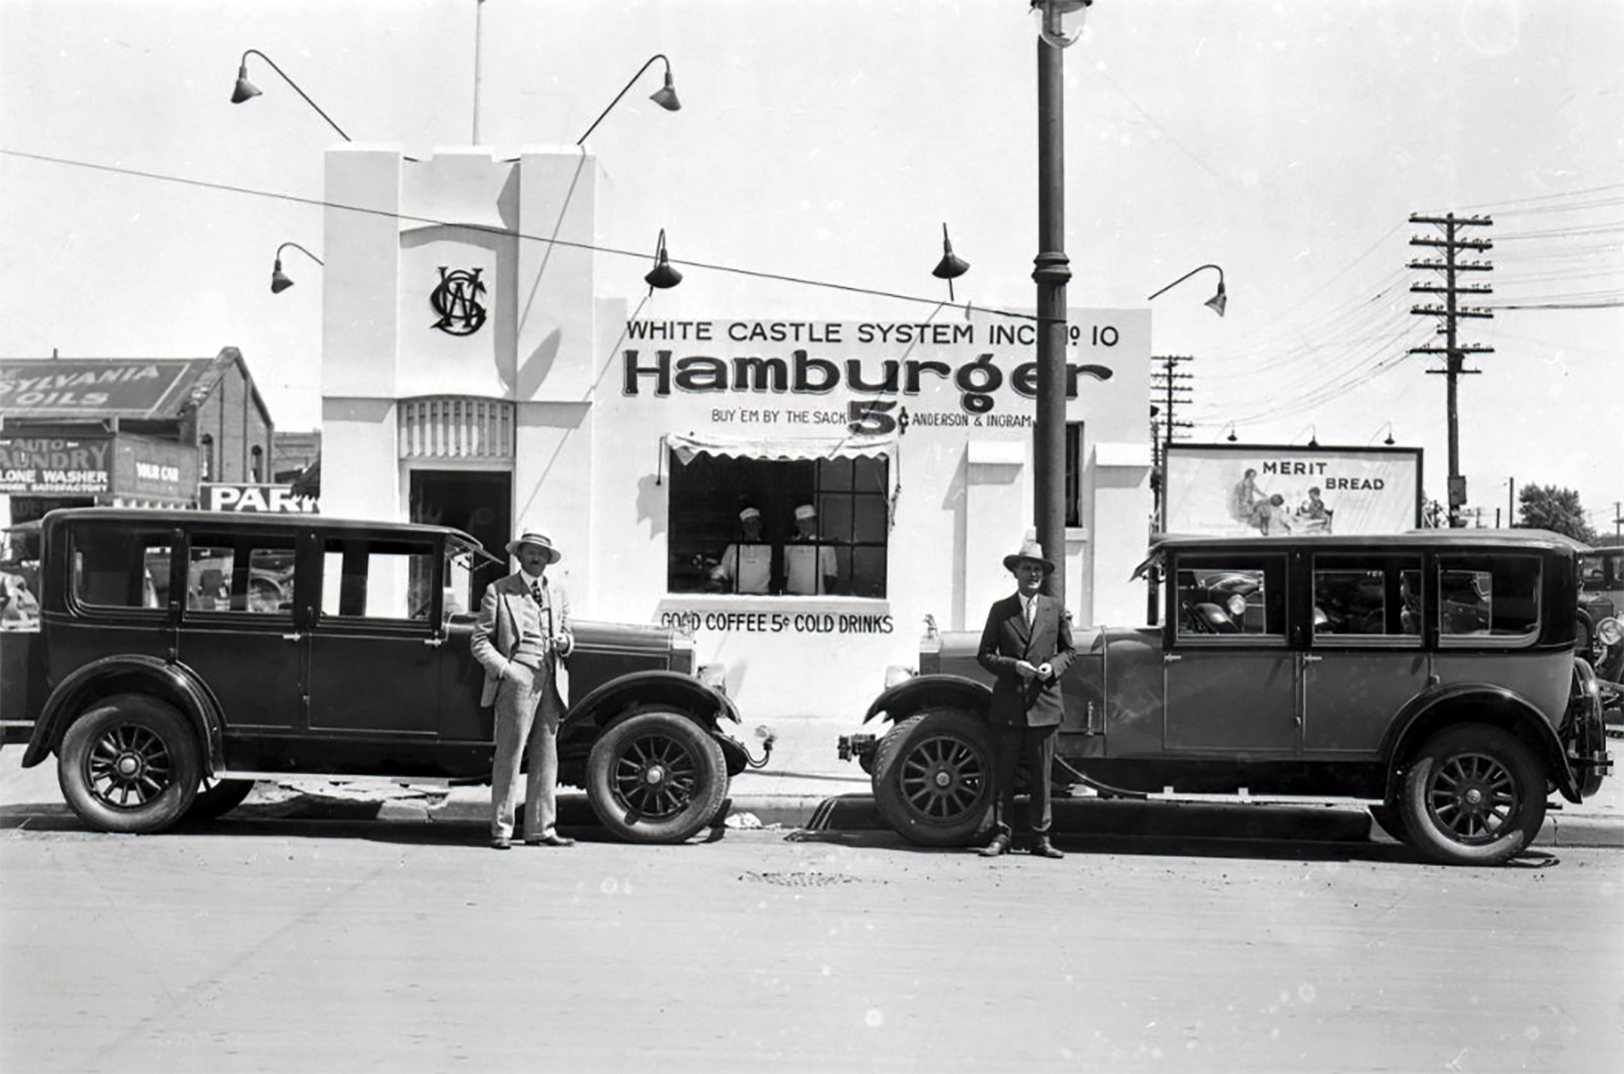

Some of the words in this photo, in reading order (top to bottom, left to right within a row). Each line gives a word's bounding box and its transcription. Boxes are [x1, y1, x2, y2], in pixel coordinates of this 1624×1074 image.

[627, 321, 713, 341] WHITE
[728, 322, 843, 343] CASTLE
[857, 324, 974, 345] SYSTEM
[1092, 325, 1120, 347] 10
[622, 349, 1114, 415] Hamburger
[15, 391, 110, 406] OILS
[712, 408, 736, 423] BUY
[763, 410, 780, 424] BY
[786, 410, 810, 424] THE
[813, 411, 848, 425] SACK
[911, 412, 969, 427] ANDERSON
[973, 414, 983, 427] &
[986, 415, 1032, 428] INGRAM
[13, 438, 65, 453] AUTO
[1263, 461, 1327, 475] MERIT
[43, 470, 108, 483] WASHER
[1325, 478, 1385, 491] BREAD
[661, 612, 701, 631] GOD
[705, 613, 767, 632] COFFEE
[770, 615, 790, 632] 5¢
[794, 615, 834, 633] COLD
[839, 616, 894, 634] DRINKS
